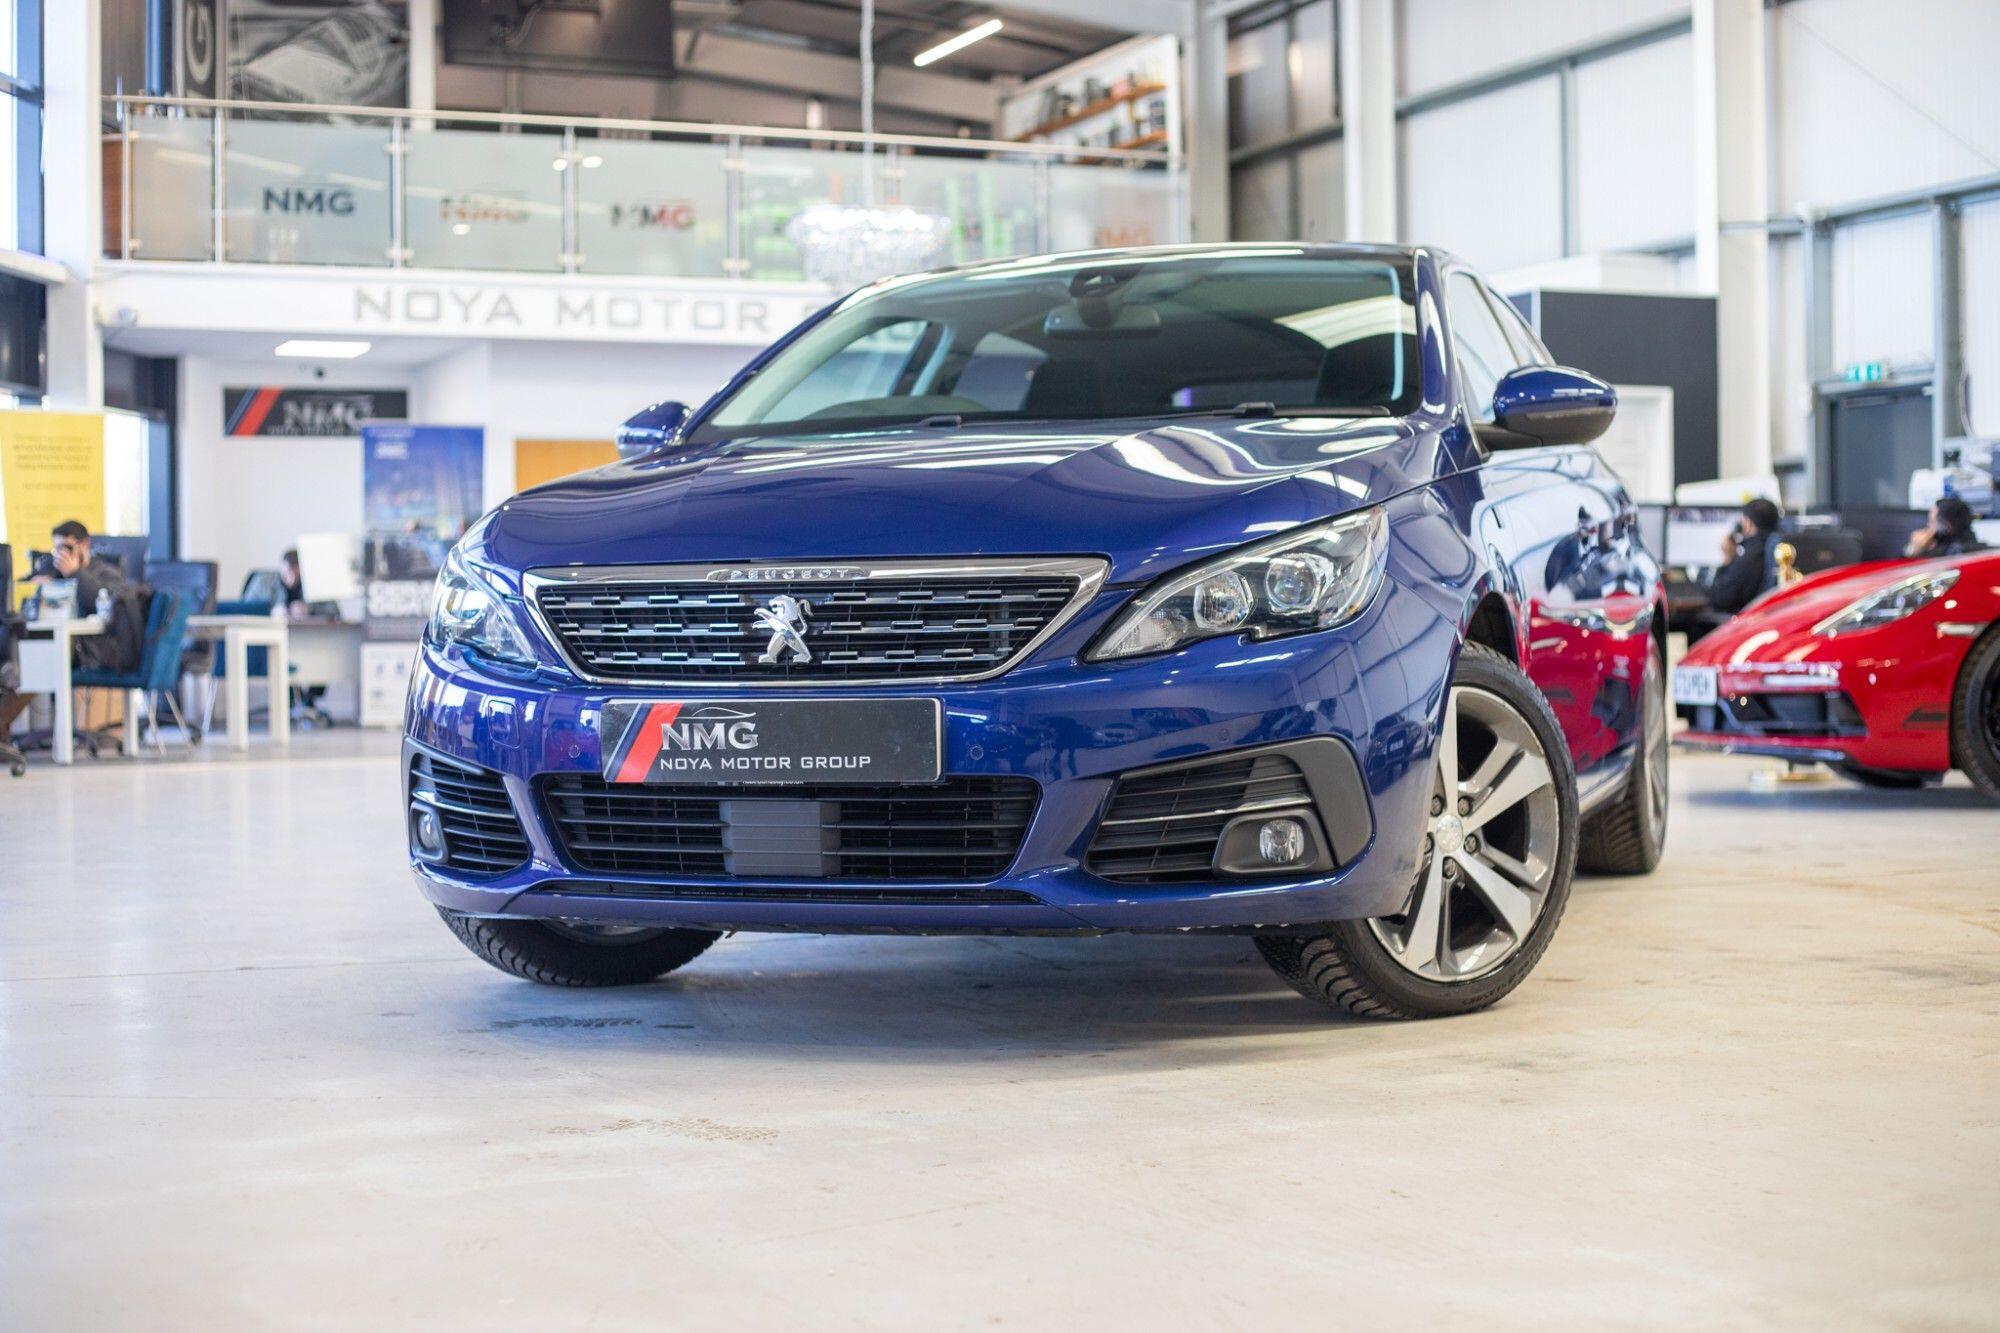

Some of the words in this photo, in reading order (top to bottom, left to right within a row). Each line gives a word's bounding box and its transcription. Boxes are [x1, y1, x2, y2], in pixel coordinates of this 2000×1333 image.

[262, 187, 357, 215] NMG
[355, 286, 523, 326] NOYA
[556, 293, 769, 331] MOTOR
[729, 568, 849, 580] PEUGEOT
[660, 721, 759, 750] NMG
[660, 757, 713, 770] NOYA
[721, 756, 792, 770] MOTOR
[800, 755, 872, 769] GROUP
